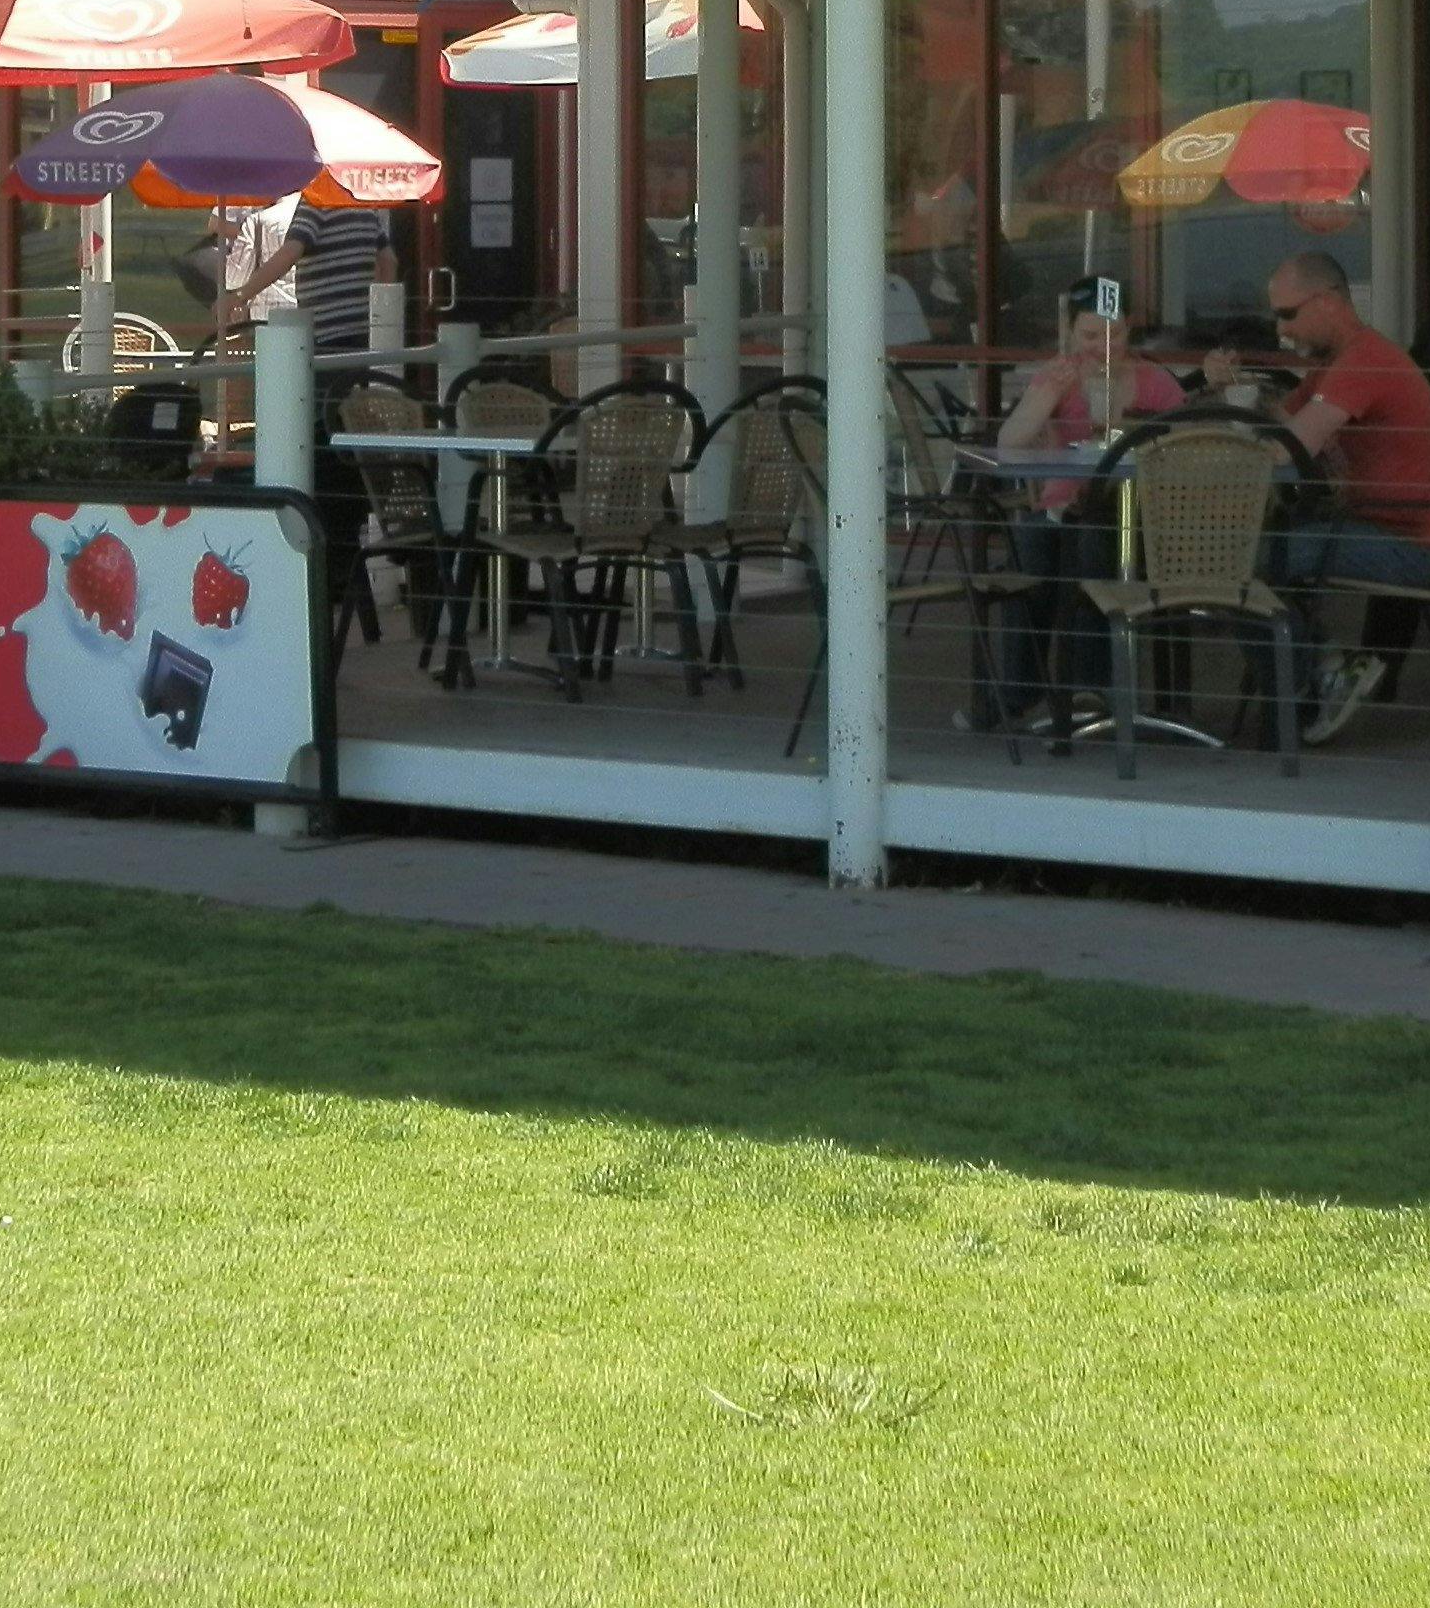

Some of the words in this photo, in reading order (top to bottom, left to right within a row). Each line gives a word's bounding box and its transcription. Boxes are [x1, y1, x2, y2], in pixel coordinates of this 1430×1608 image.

[37, 161, 126, 185] STREETS
[341, 167, 418, 190] STREETS
[1103, 285, 1116, 314] 15
